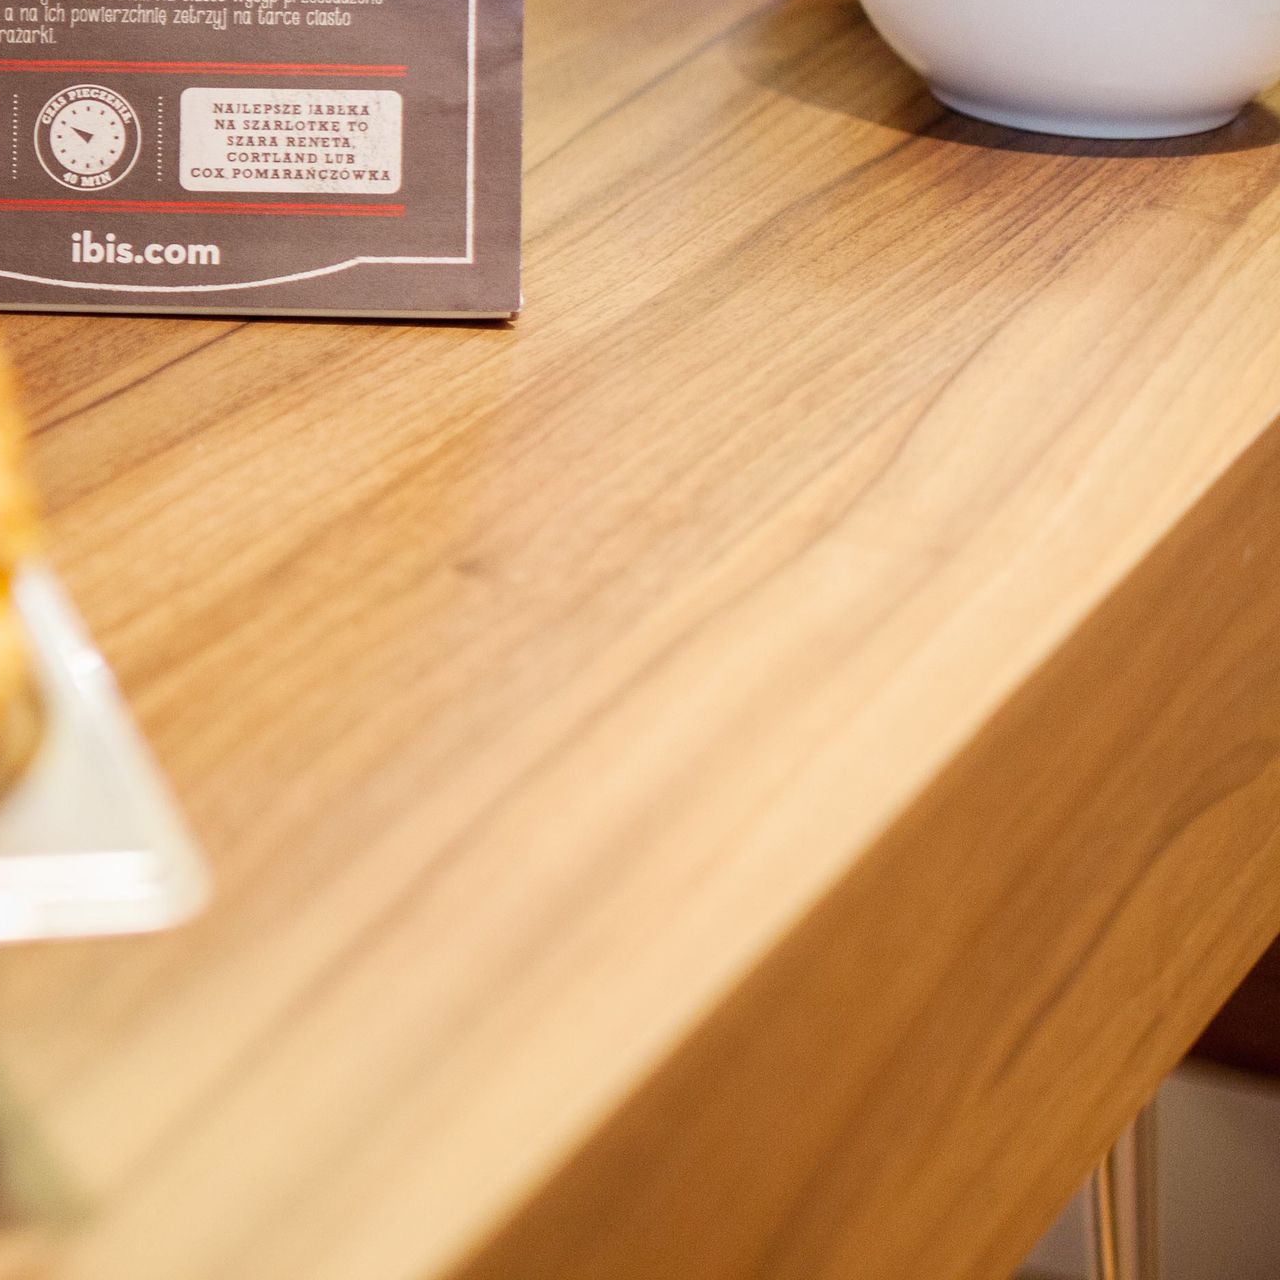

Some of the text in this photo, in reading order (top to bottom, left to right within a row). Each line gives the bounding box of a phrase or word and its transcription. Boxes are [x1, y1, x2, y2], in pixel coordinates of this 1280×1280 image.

[4, 7, 14, 22] a
[20, 7, 39, 22] na
[43, 3, 66, 22] ich
[70, 3, 167, 28] powierzchnię
[172, 5, 228, 30] zetrzyj
[233, 10, 252, 25] na
[257, 5, 301, 26] tarce
[306, 6, 352, 27] ciasto
[212, 102, 371, 116] NAJLEPSZE JABŁKA
[214, 119, 369, 132] NA SZARLOTKĘ TO
[226, 135, 356, 150] SZARA RENETA,
[226, 152, 356, 164] CORTLAND LUB
[80, 171, 113, 187] MIN
[190, 166, 391, 181] COX POMARAŃCZÓWKA
[71, 229, 221, 265] ibis.com
